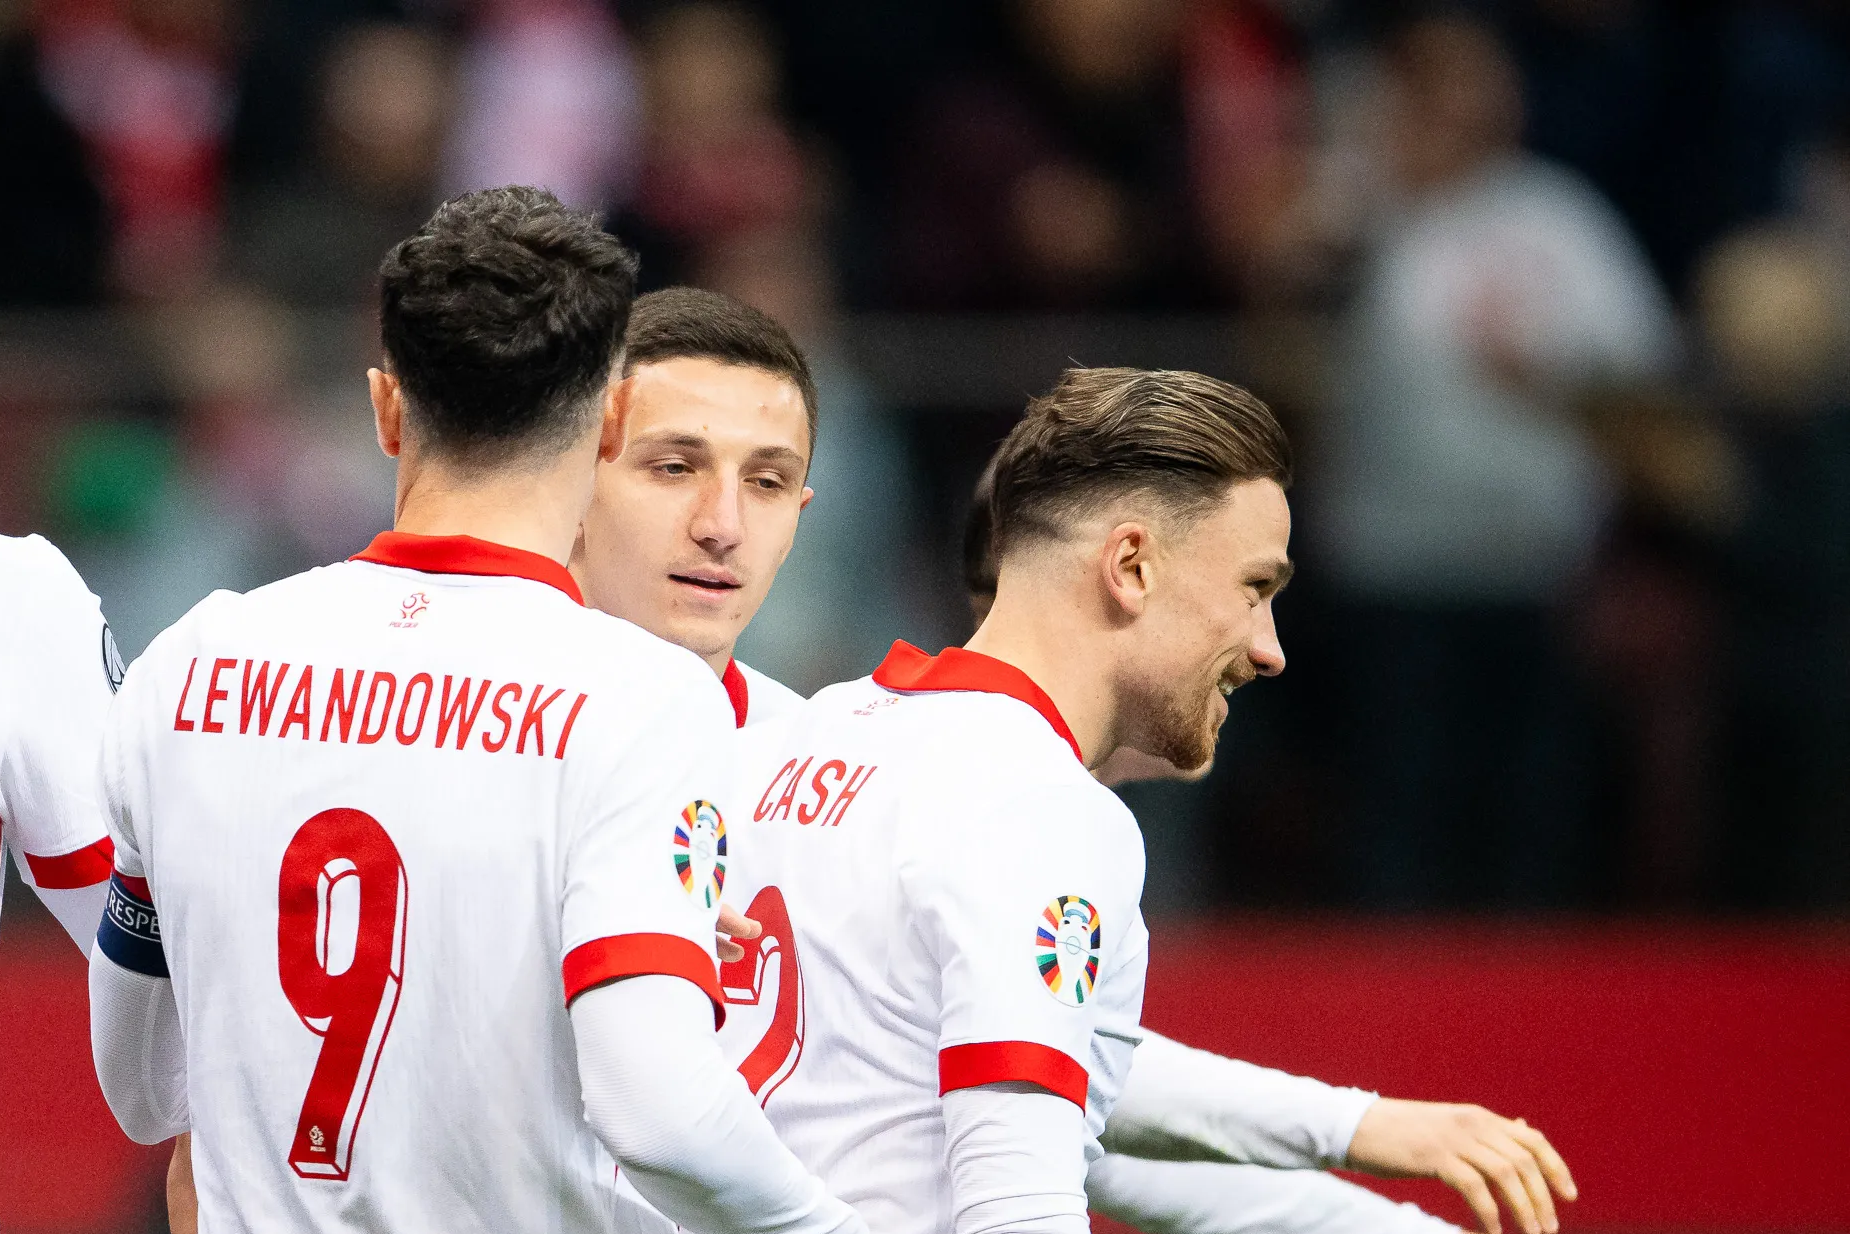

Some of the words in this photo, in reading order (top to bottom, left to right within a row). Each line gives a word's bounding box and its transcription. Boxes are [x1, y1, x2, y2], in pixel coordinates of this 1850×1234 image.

[173, 657, 588, 761] LEWANDOWSKI
[753, 756, 877, 827] CASH
[277, 807, 409, 1182] 9
